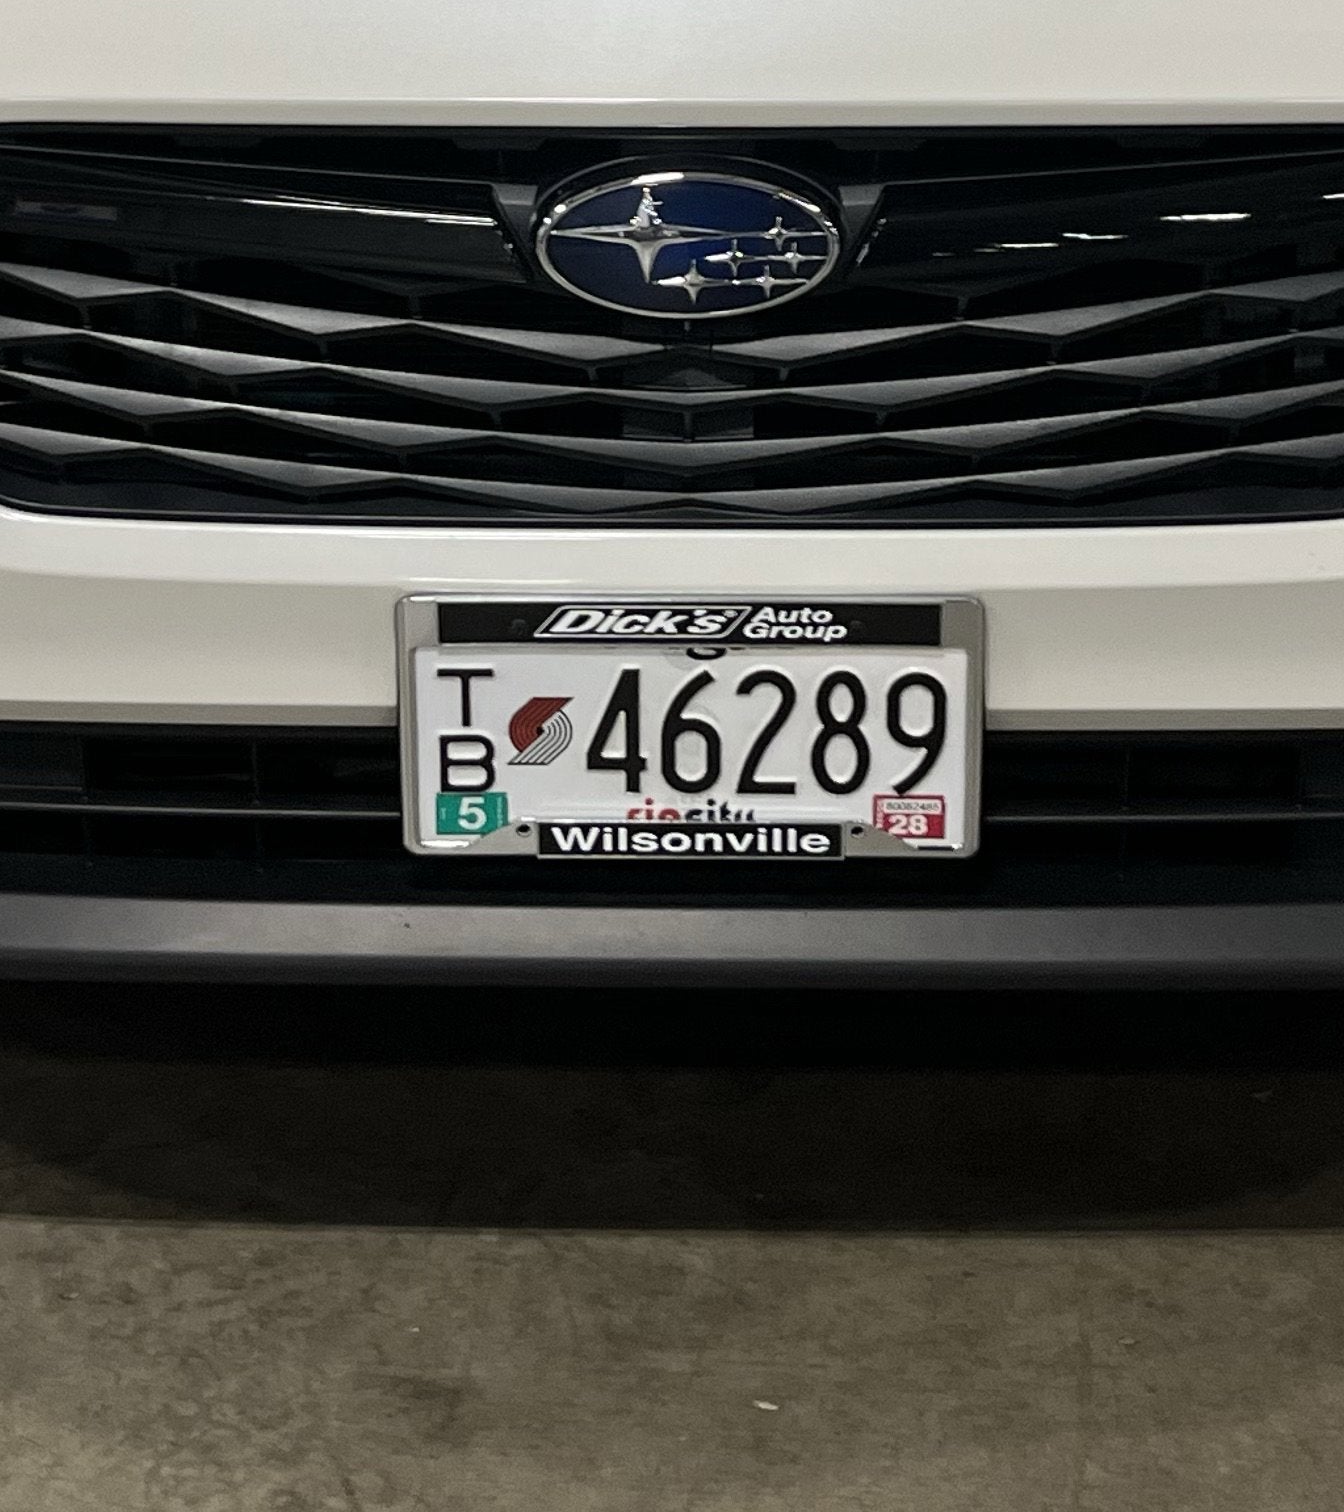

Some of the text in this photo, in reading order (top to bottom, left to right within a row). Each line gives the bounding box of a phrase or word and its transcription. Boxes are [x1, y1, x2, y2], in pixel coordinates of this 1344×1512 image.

[549, 608, 729, 634] Dick's
[751, 606, 834, 625] Auto
[742, 622, 848, 643] Group
[586, 669, 948, 795] 46289
[457, 796, 488, 831] 5
[888, 814, 929, 836] 28
[551, 826, 832, 853] Wilsonville
